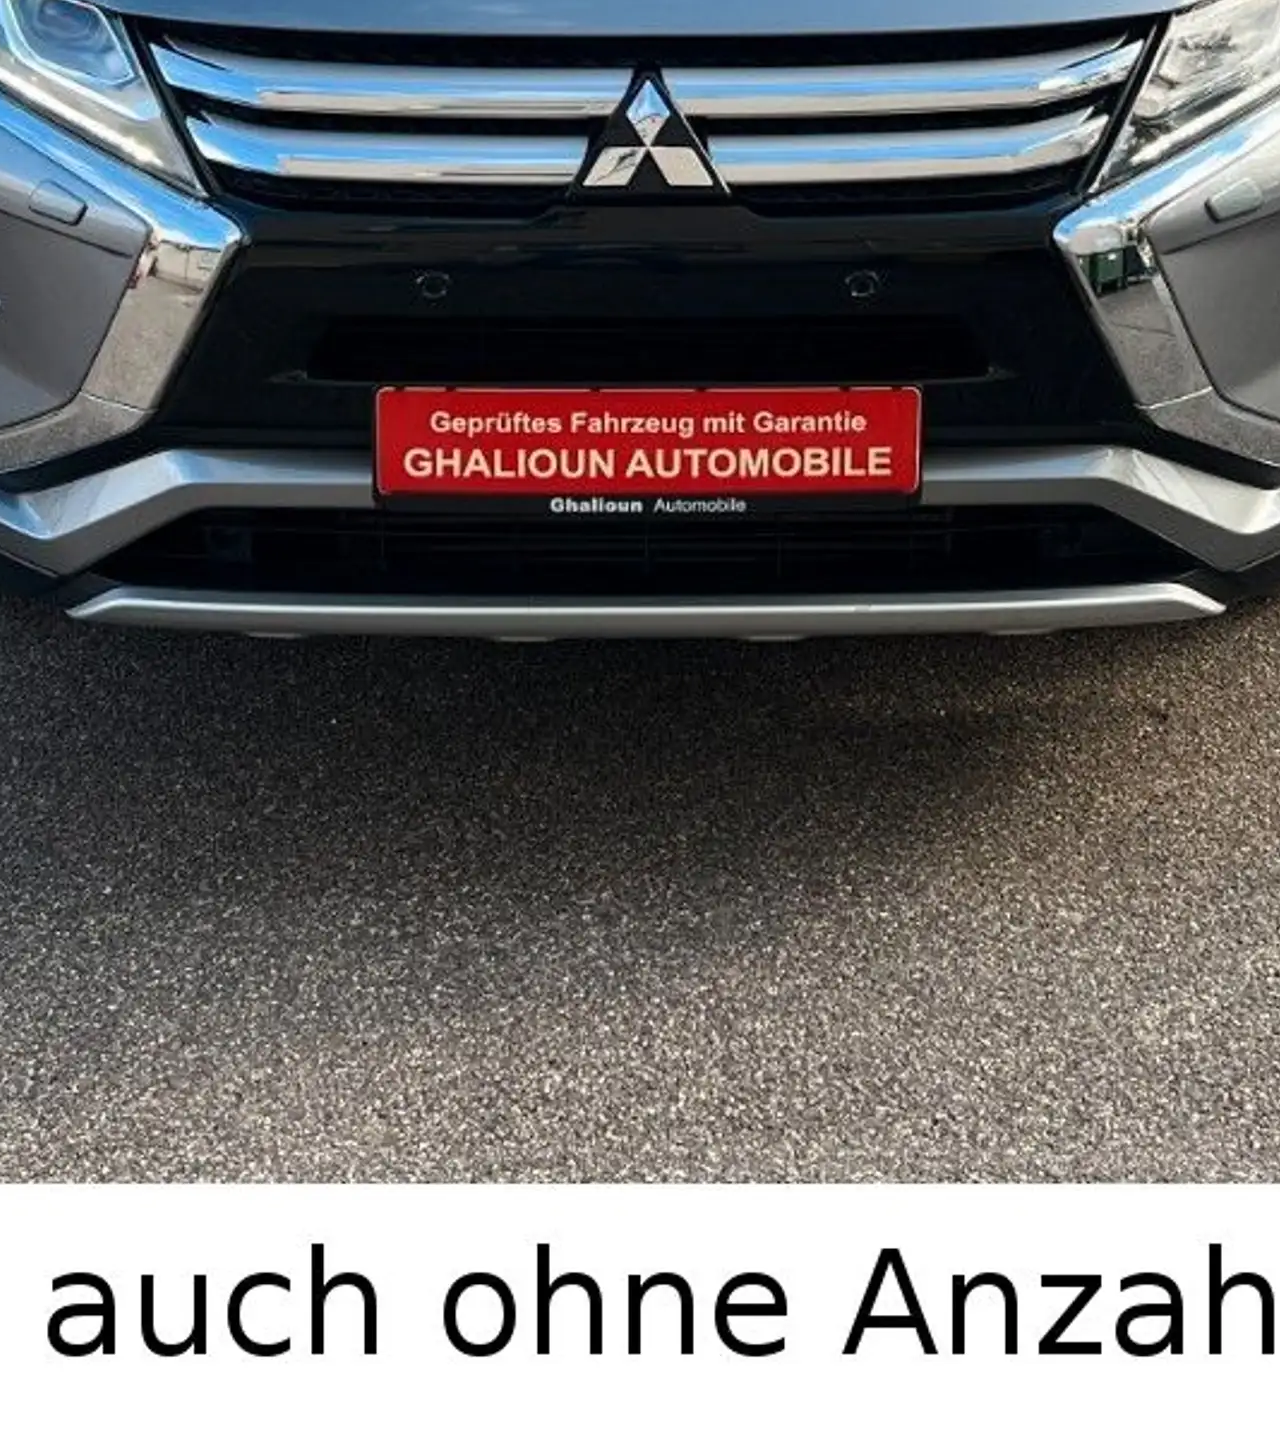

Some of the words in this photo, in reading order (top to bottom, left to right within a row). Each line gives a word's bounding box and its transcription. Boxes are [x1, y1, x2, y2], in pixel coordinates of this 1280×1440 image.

[429, 410, 562, 439] Geprüftes
[570, 411, 695, 439] Fahrzeug
[702, 411, 746, 434] mit
[752, 411, 868, 434] Garantie
[403, 447, 615, 479] GHALIOUN
[624, 446, 892, 479] AUTOMOBILE
[550, 497, 643, 513] Ghalioun
[652, 497, 747, 513] Automobile
